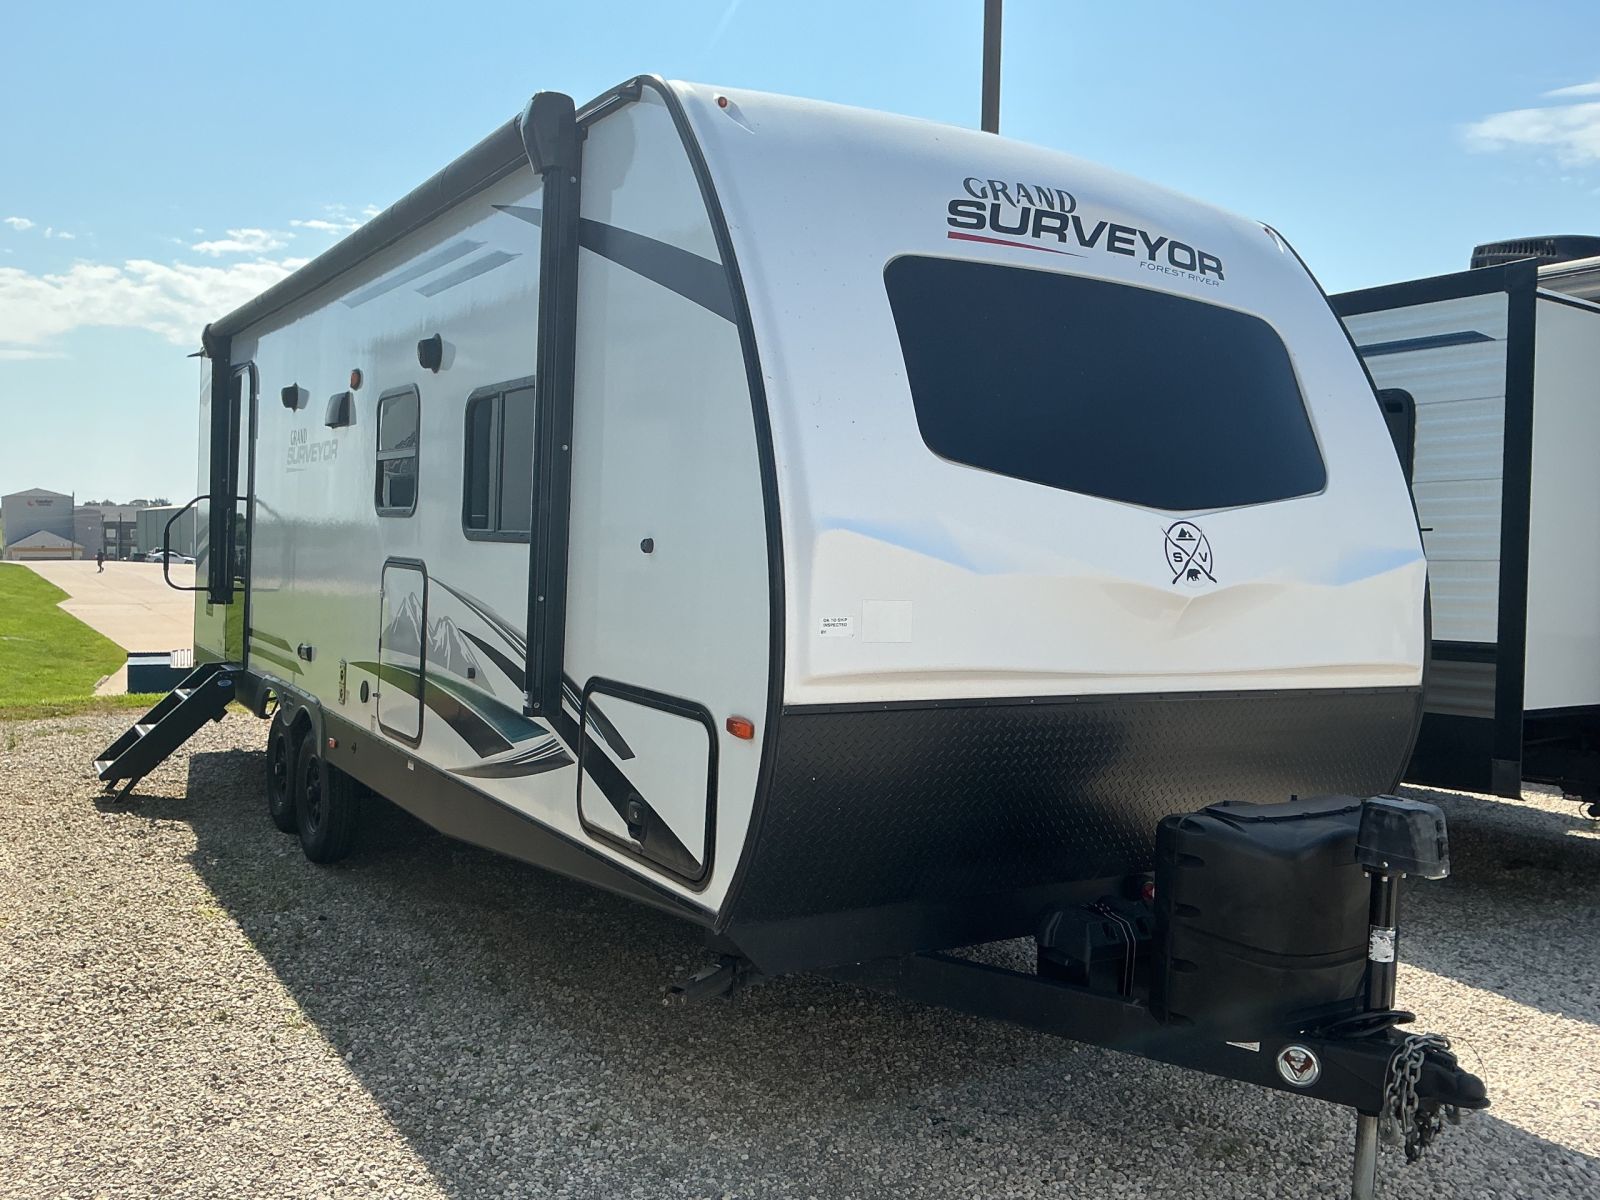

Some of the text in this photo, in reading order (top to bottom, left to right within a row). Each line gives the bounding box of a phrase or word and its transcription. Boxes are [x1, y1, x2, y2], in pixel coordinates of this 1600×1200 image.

[963, 177, 1077, 214] GRAND
[947, 199, 1225, 281] SURVEYOR
[1139, 261, 1220, 287] FOREST RIVER
[290, 428, 308, 446] GRAND
[286, 438, 339, 465] SURVEYOR
